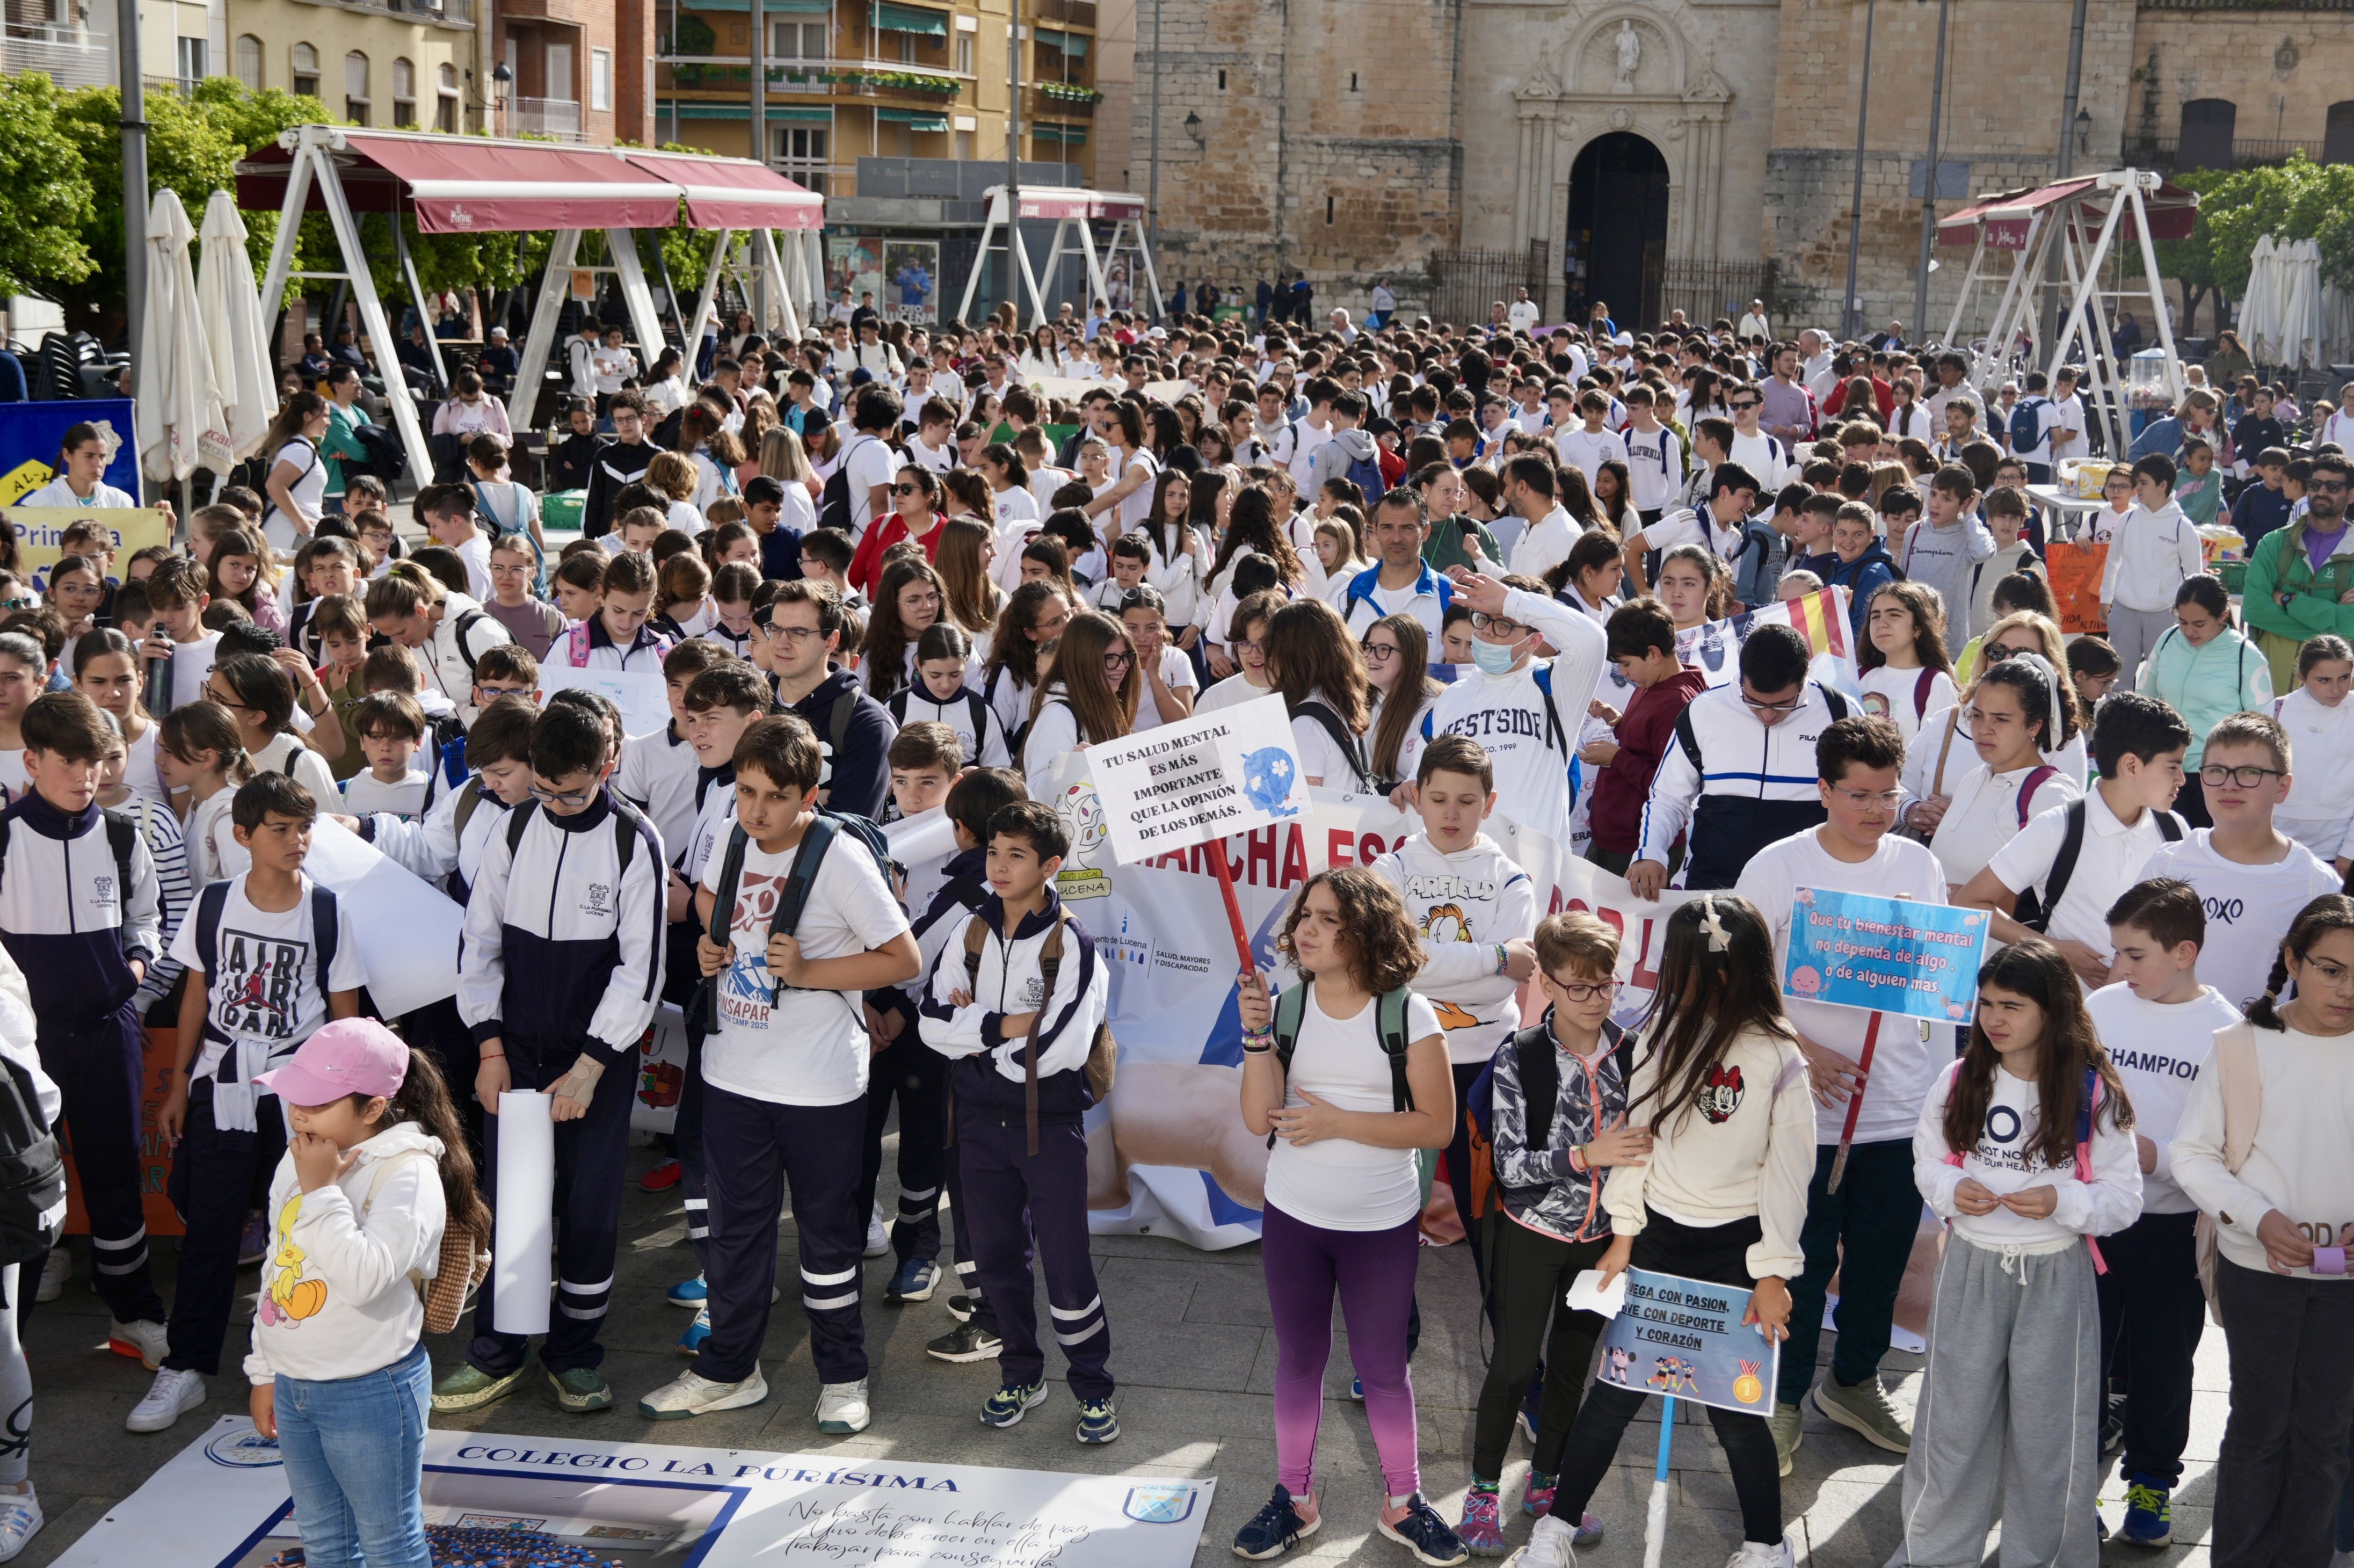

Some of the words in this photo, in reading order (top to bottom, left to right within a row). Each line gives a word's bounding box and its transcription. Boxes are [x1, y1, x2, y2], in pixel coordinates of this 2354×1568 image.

[1909, 546, 1953, 560] Champion
[1103, 754, 1123, 768] TU
[1127, 742, 1169, 761] SALUD
[1171, 725, 1230, 750] MENTAL
[1499, 743, 1517, 753] 1999
[1149, 763, 1167, 776] ES
[1168, 754, 1198, 771] MÁS
[1134, 768, 1223, 801] IMPORTANTE
[1130, 805, 1160, 823] QUE
[1161, 801, 1179, 813] LA
[1181, 785, 1237, 808] OPINIÓN
[1139, 826, 1159, 840] DE
[1160, 818, 1188, 834] LOS
[1189, 804, 1242, 826] DEMÁS.
[1404, 875, 1498, 901] ARFIELD
[1808, 911, 1833, 927] Que
[1836, 914, 1852, 930] tu
[1855, 917, 1921, 940] bienestar
[1924, 930, 1974, 948] mental
[1120, 936, 1147, 949] Lucena
[230, 939, 297, 981] AIR
[1156, 950, 1179, 961] SALUD,
[1180, 955, 1211, 964] MAYORES
[1160, 960, 1209, 973] DISCAPACIDAD
[1815, 939, 1831, 952] no
[1834, 939, 1891, 961] dependa
[1894, 948, 1913, 964] de
[1915, 953, 1948, 972] algo
[1824, 965, 1833, 977] o
[1836, 964, 1854, 979] de
[1856, 968, 1907, 989] alguien
[1910, 977, 1942, 994] más.
[732, 1017, 749, 1026] CAMP
[751, 1021, 768, 1029] 2025
[1977, 1143, 1999, 1156] NOT
[1984, 1156, 2002, 1169] YOUR
[1659, 1289, 1683, 1303] CON
[1685, 1294, 1730, 1313] PASION,
[1644, 1307, 1667, 1320] CON
[1670, 1311, 1725, 1332] DEPORTE
[1636, 1326, 1644, 1337] Y
[1647, 1329, 1702, 1349] CORAZÓN
[456, 1446, 649, 1470] COLEGIO
[659, 1459, 718, 1477] LA
[730, 1465, 961, 1492] PURÍSIMA
[789, 1500, 824, 1520] No
[832, 1501, 895, 1526] basta
[944, 1510, 1015, 1534] hablar
[1020, 1517, 1044, 1530] de
[809, 1518, 859, 1538] Uno
[866, 1522, 914, 1540] debe
[921, 1533, 971, 1543] creer
[875, 1546, 924, 1562] para
